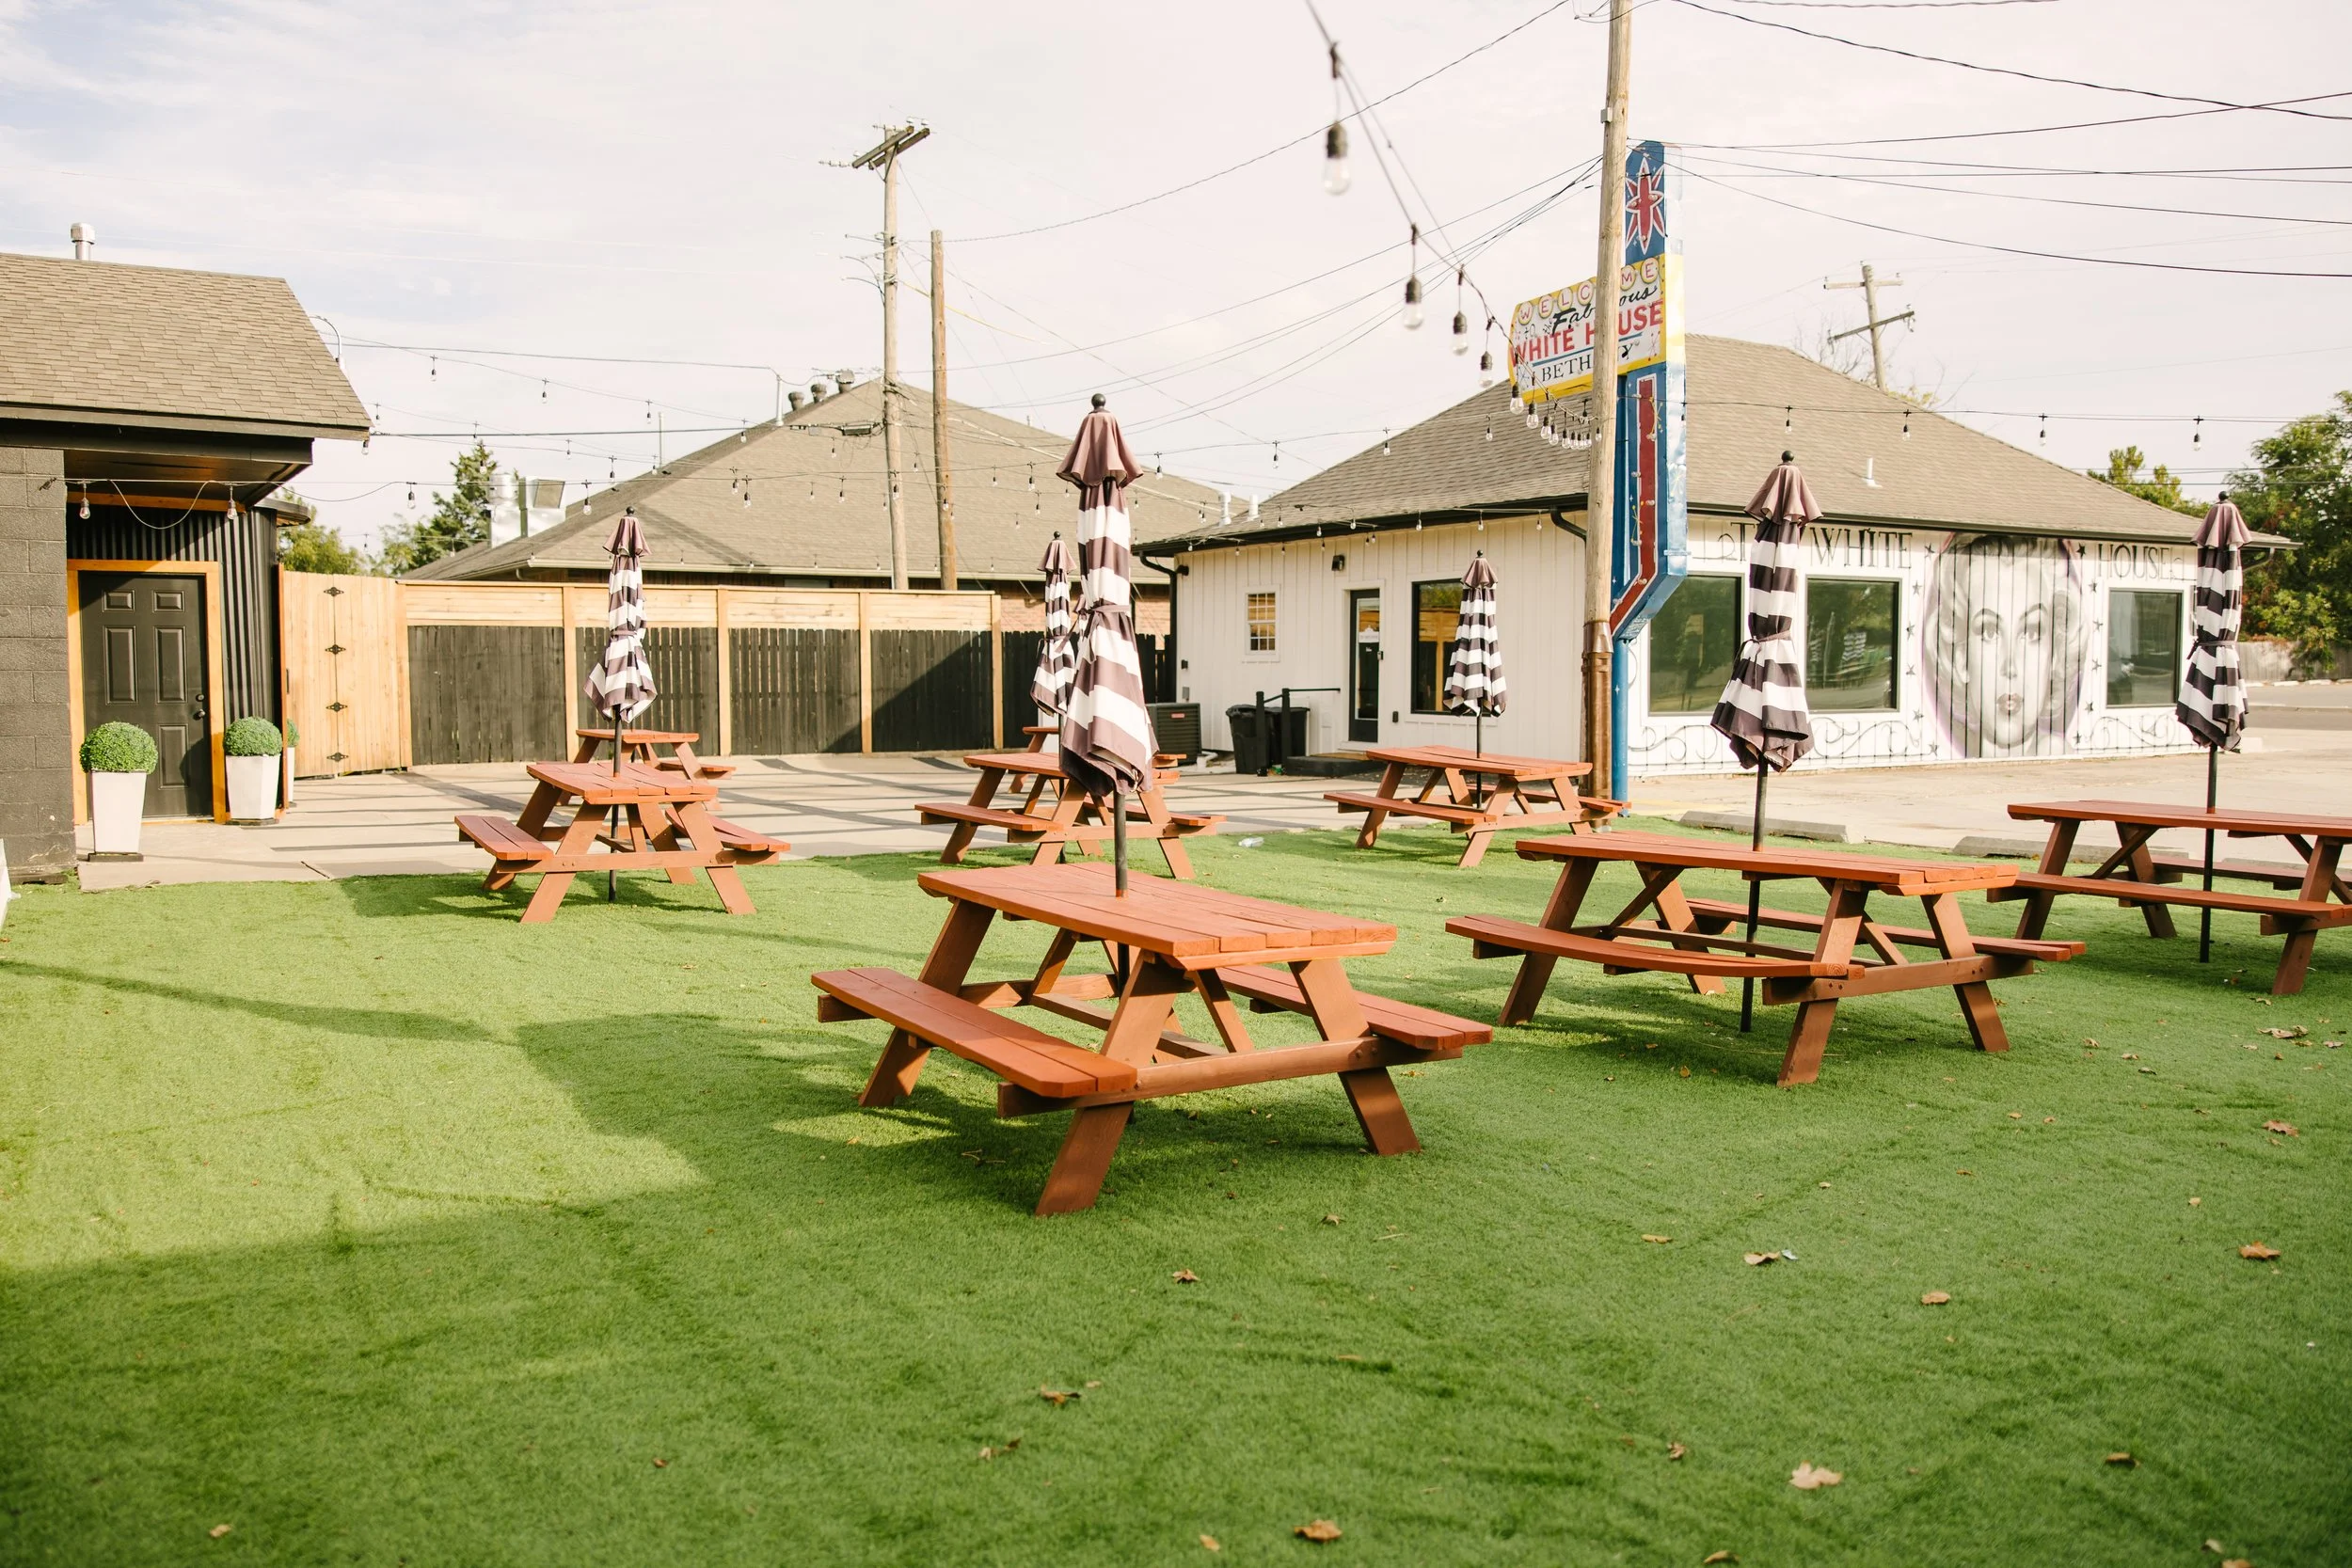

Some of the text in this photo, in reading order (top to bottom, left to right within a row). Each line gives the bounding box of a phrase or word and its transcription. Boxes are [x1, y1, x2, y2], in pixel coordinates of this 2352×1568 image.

[1520, 261, 1654, 320] WELCME
[1551, 285, 1658, 337] Fabous
[1509, 299, 1663, 368] WHITE HUSE
[1542, 342, 1633, 382] BETHY
[1809, 527, 2169, 580] WHITE HOUSE
